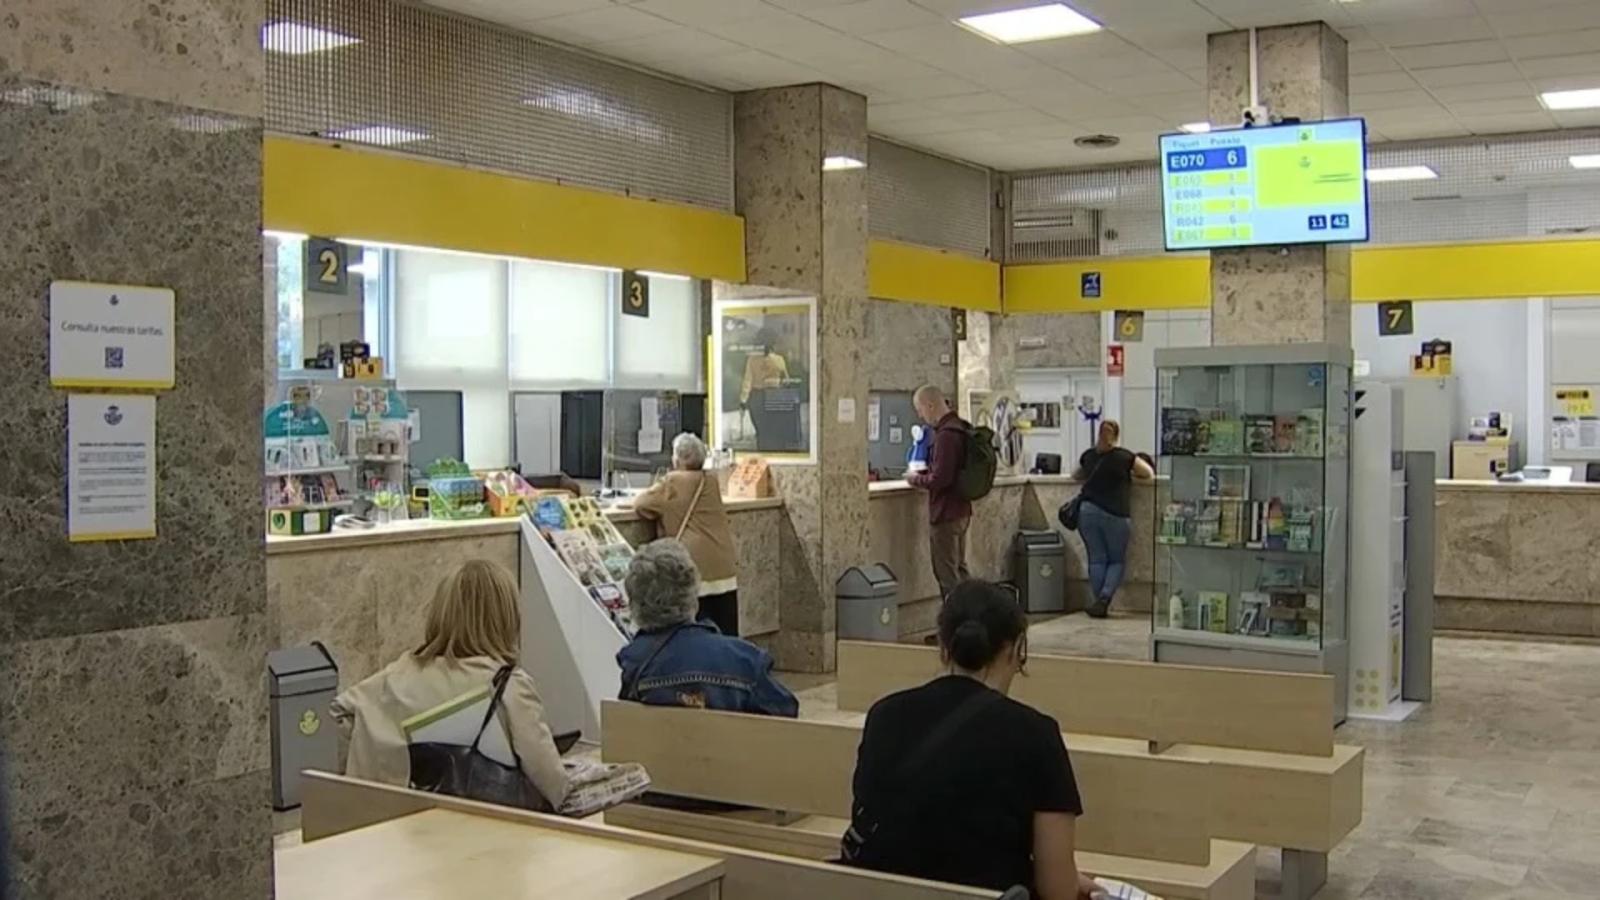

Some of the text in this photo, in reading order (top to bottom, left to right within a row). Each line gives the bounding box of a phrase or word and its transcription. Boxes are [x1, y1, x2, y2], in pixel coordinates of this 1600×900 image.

[1171, 150, 1238, 168] E070 6
[1311, 217, 1325, 227] 11
[319, 249, 338, 282] 2
[630, 281, 643, 307] 3
[61, 320, 98, 333] Consulta
[101, 324, 135, 335] nuestras
[955, 315, 963, 334] 5
[1120, 317, 1135, 336] 6
[1387, 308, 1403, 329] 7
